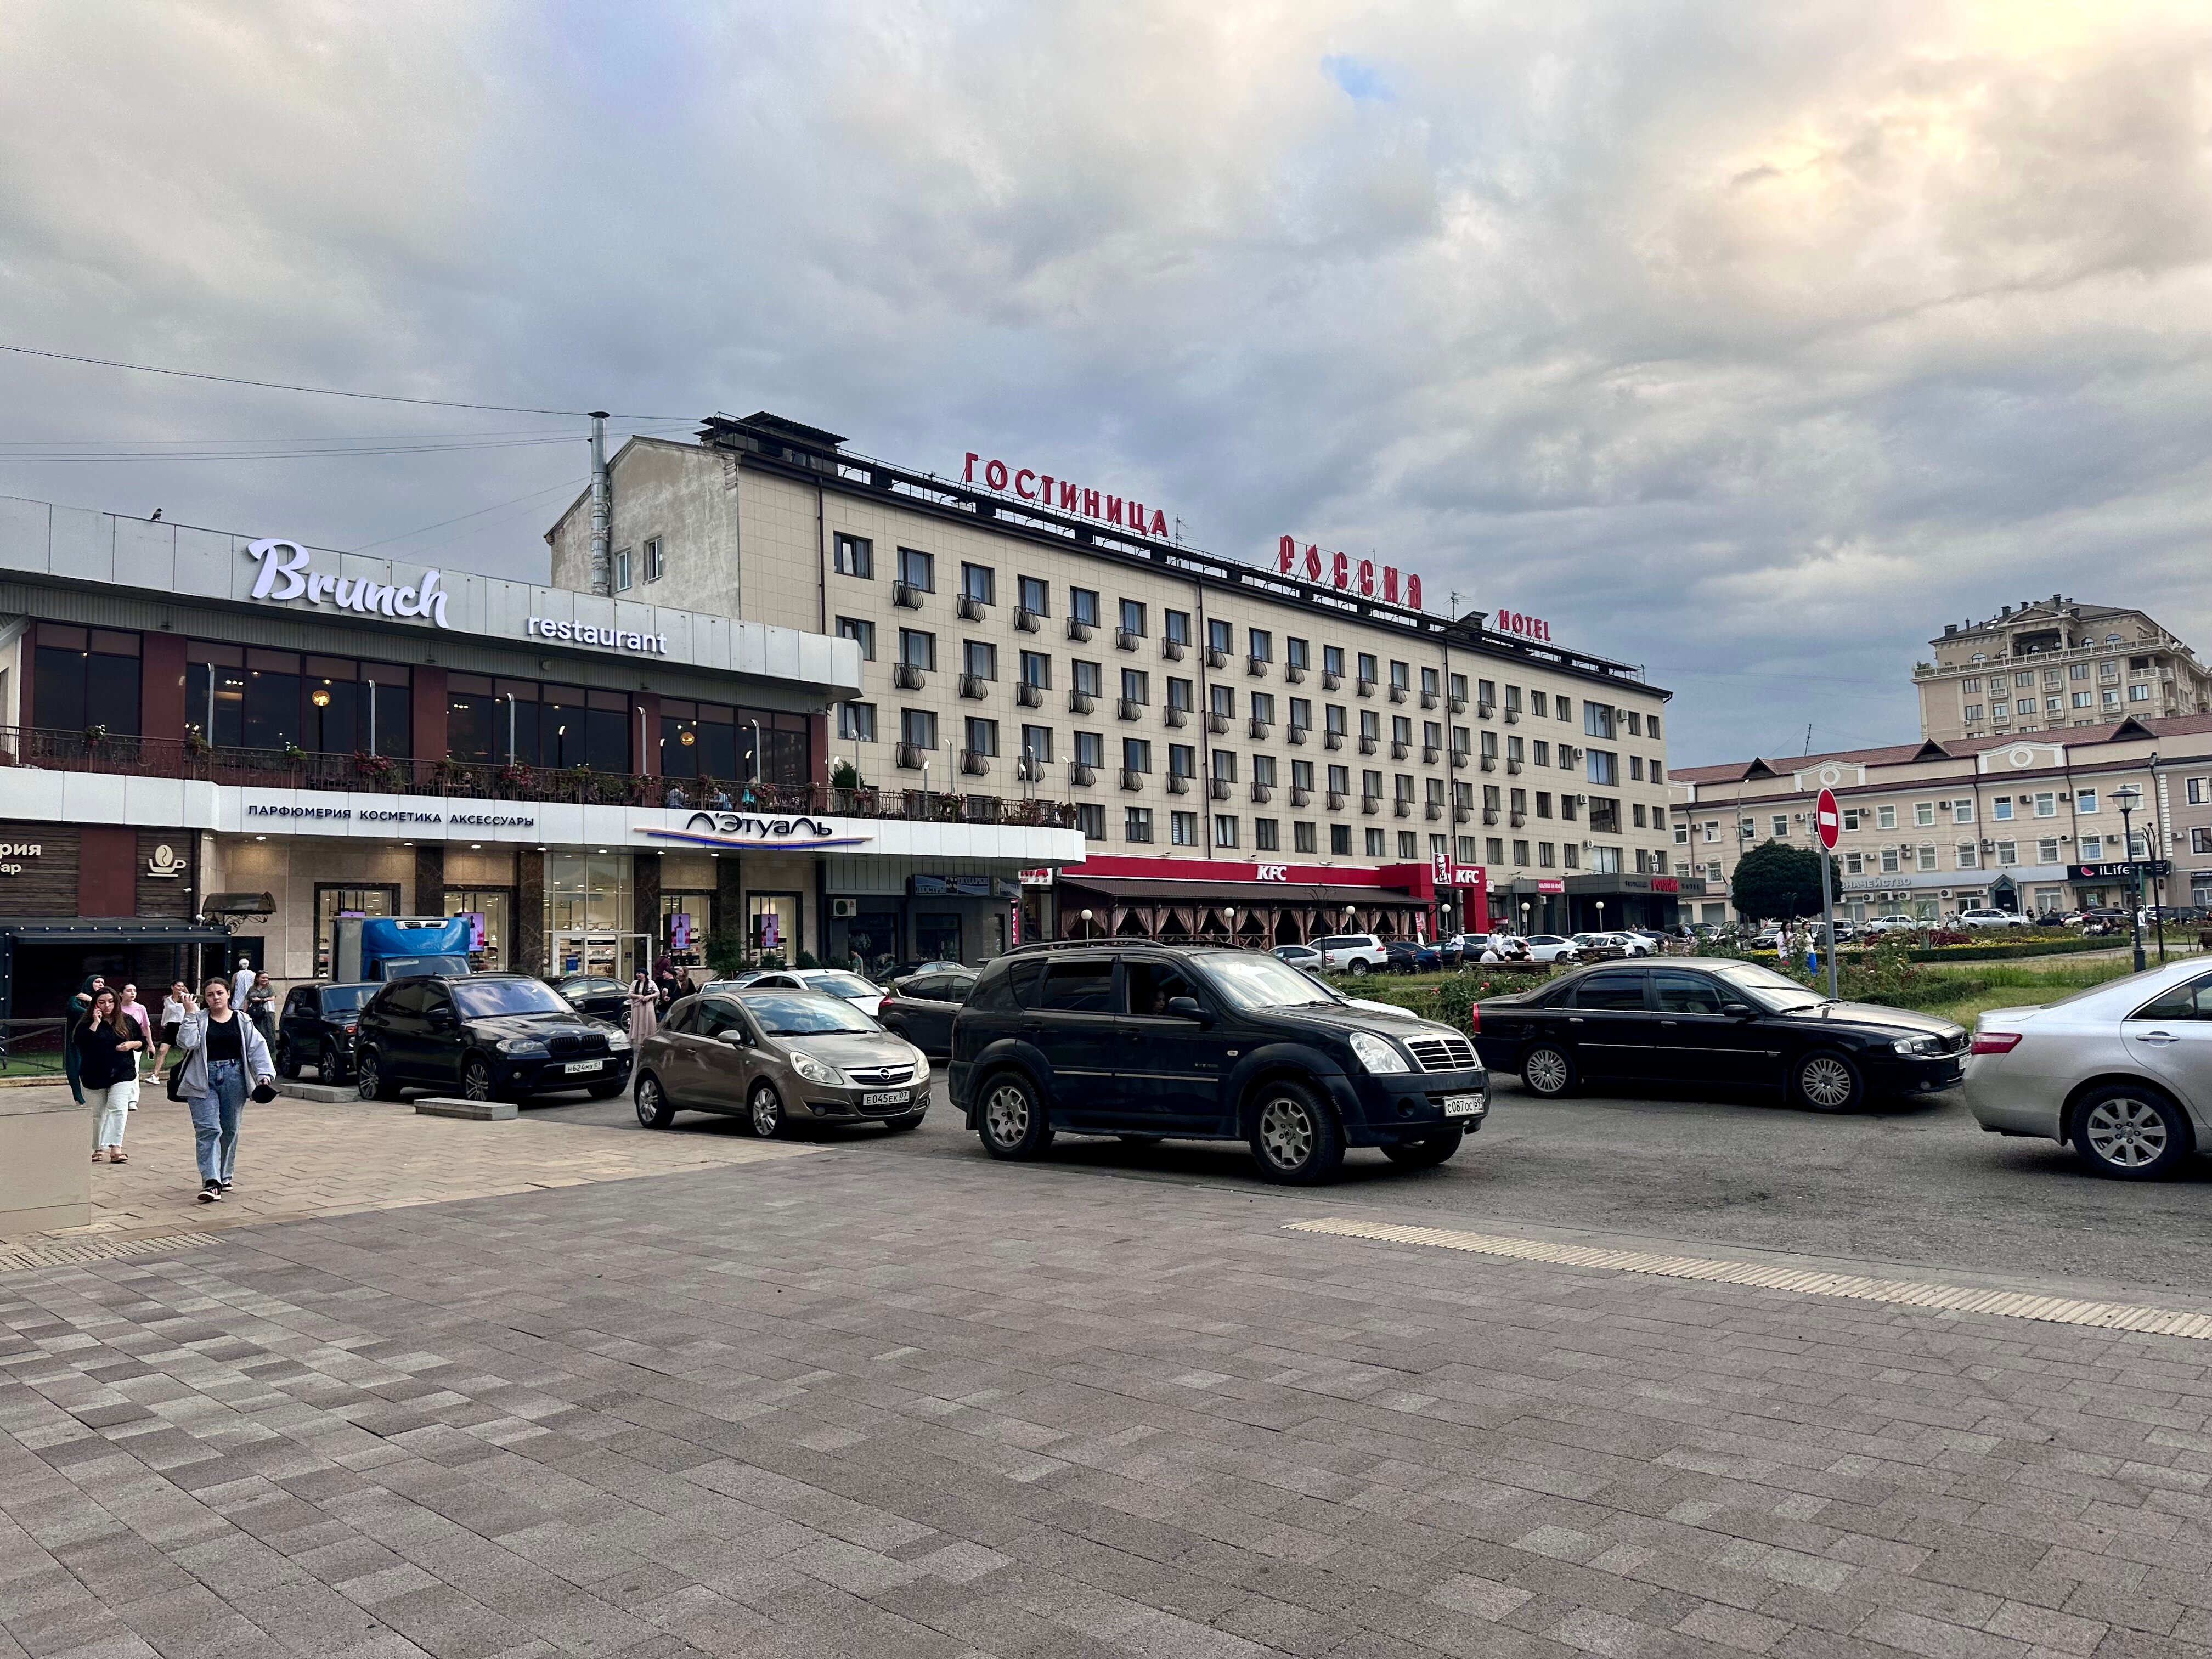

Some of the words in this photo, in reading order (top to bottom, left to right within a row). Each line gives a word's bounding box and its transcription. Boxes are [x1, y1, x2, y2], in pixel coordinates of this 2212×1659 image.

[966, 452, 1169, 538] ГОСТИНИЦА
[247, 538, 449, 629] Brunch
[1280, 535, 1421, 610] РОССИЯ
[527, 616, 668, 654] restaurant
[1499, 608, 1551, 641] HOTEL
[248, 805, 351, 819] ПАРФЮМЕРИЯ
[360, 810, 442, 823] КОСМЕТИКА
[449, 814, 534, 827] АКСЕССУАРЫ
[0, 862, 22, 875] ар
[1256, 865, 1287, 881] KFC
[1455, 869, 1479, 884] KFC
[2100, 865, 2130, 876] iLife
